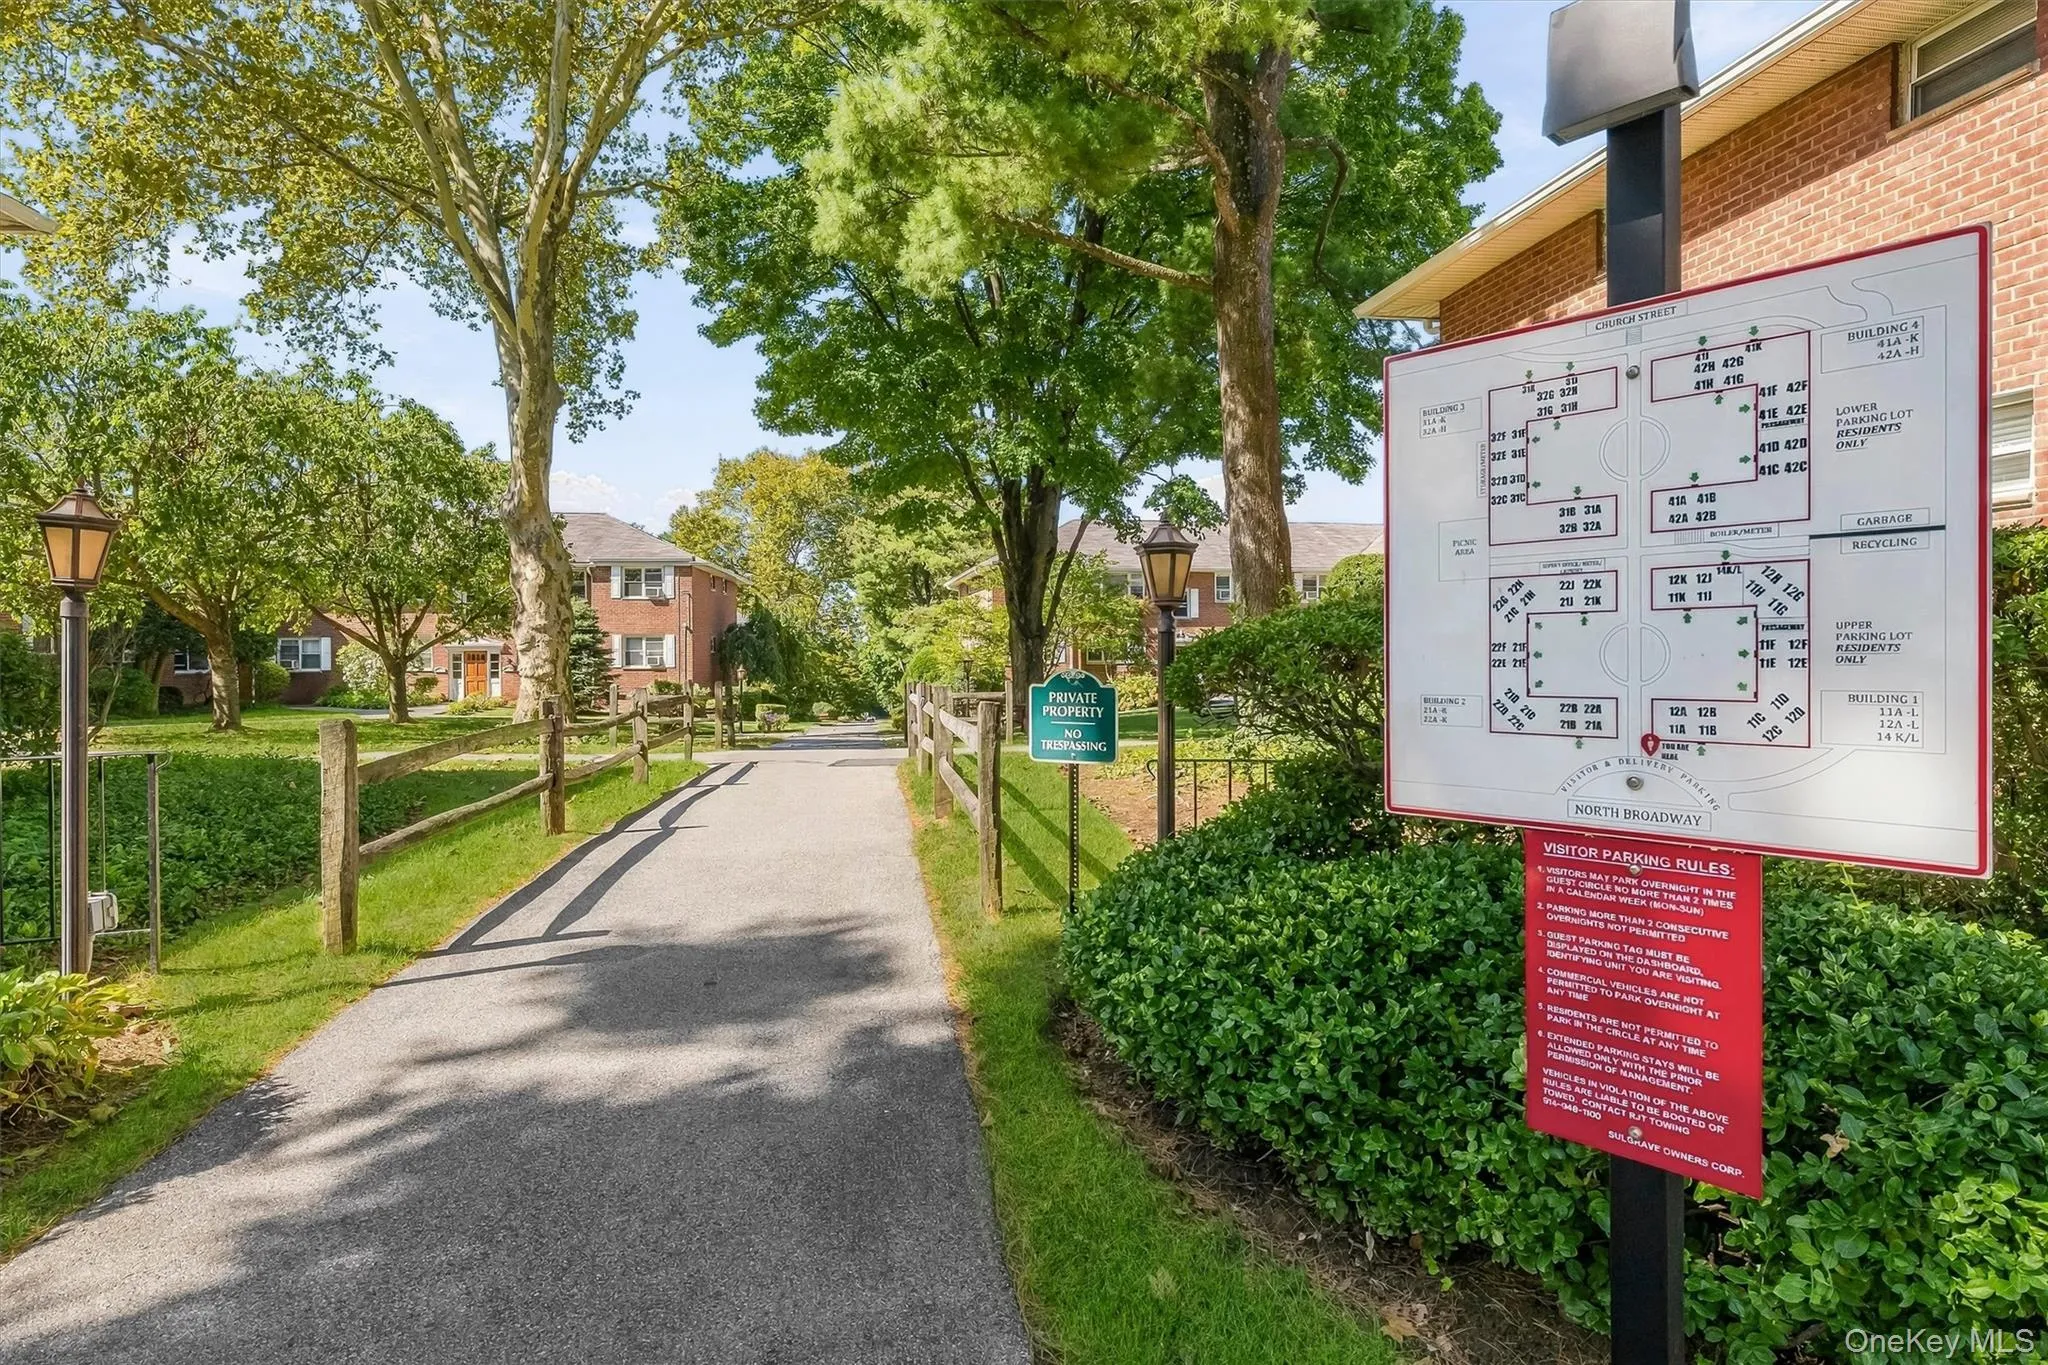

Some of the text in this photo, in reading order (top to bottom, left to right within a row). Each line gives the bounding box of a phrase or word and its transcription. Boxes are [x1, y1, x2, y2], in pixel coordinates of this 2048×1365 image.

[1595, 306, 1677, 330] CHURCH STREET
[1847, 320, 1919, 341] BUILDING 4
[1877, 337, 1902, 348] 41A
[1877, 350, 1902, 360] 42A
[1758, 380, 1808, 398] 41F 42F
[1423, 404, 1458, 417] BUILDING
[1758, 403, 1808, 420] 41E 42E
[1836, 402, 1878, 416] LOWER
[1836, 409, 1914, 427] PARKING LOT
[1491, 429, 1526, 443] 32F 31F
[1836, 422, 1902, 439] RESIDENTS
[1836, 438, 1868, 450] ONLY
[1491, 448, 1526, 462] 32E 31E
[1758, 460, 1808, 476] 41C 42C
[1491, 493, 1526, 505] 32C 31C
[1668, 492, 1716, 506] 41A 41B
[1668, 510, 1717, 524] 42A 42B
[1857, 514, 1913, 526] GARBAGE
[1710, 527, 1773, 538] BOILER/METER
[1852, 537, 1918, 550] RECYCLING
[1455, 548, 1475, 556] AREA
[1836, 621, 1873, 630] UPPER
[1836, 632, 1913, 641] PARKING LOT
[1759, 639, 1808, 650] 11F 12F
[1836, 643, 1901, 652] RESIDENTS
[1759, 658, 1808, 668] 11E 12E
[1835, 655, 1867, 664] ONLY
[1049, 692, 1097, 704] PRIVATE
[1423, 697, 1460, 705] BUILDING
[1848, 694, 1918, 704] BUILDING 1
[1042, 705, 1104, 718] PROPERTY
[1669, 706, 1717, 718] 12A 12B
[1770, 693, 1806, 724] 11D 12D
[1880, 707, 1919, 717] 11A -L
[1669, 724, 1717, 736] 11A 11B
[1747, 712, 1783, 743] 11C 12C
[1880, 720, 1919, 729] 12A -L
[1064, 729, 1082, 739] NO
[1878, 732, 1919, 744] 14 K/L
[1041, 740, 1107, 752] TRESPASSING
[1560, 764, 1599, 793] VISITOR
[1618, 758, 1674, 774] DELIVERY
[1680, 773, 1721, 811] PARKING
[1575, 804, 1702, 826] NORTH BROADWAY
[1543, 842, 1735, 876] VISITOR PARKING RULES:
[1546, 866, 1587, 879] VISITORS
[1589, 872, 1609, 882] MAY
[1612, 876, 1638, 886] PARK
[1641, 879, 1700, 894] OVERNIGHT
[1703, 888, 1713, 896] IN
[1716, 889, 1736, 899] THE
[1546, 876, 1576, 887] GUEST
[1579, 881, 1612, 892] CIRCLE
[1615, 885, 1629, 893] NO
[1631, 887, 1660, 899] MORE
[1663, 892, 1690, 903] THAN
[1702, 898, 1734, 910] TIMES
[1546, 885, 1704, 916] IN A CALENDAR WEEK (MON-SUN)
[1546, 903, 1587, 916] PARKING
[1589, 910, 1616, 920] MORE
[1619, 915, 1645, 926] THAN
[1648, 919, 1653, 927] 2
[1656, 921, 1729, 940] CONSECUTIVE
[1546, 913, 1686, 943] OVERNIGHTS NOT PERMITTED
[1547, 931, 1577, 942] GUEST
[1579, 937, 1621, 950] PARKING
[1623, 944, 1643, 954] TAG
[1646, 949, 1673, 960] MUST
[1676, 953, 1690, 964] BE
[1547, 940, 1704, 977] DISPLAYED ON THE DASHBOARD.
[1547, 1032, 1595, 1050] EXTENDED
[1597, 1044, 1639, 1060] PARKING
[1642, 1055, 1675, 1070] STAYS
[1677, 1064, 1703, 1077] WILL
[1705, 1071, 1720, 1081] BE
[1547, 1042, 1703, 1087] ALLOWED ONLY WITH THE PRIOR
[1547, 1050, 1694, 1095] PERMISSION OF MANAGEMENT.
[1543, 1067, 1729, 1124] VEHICLES IN VIOLATION OF THE ABOVE
[1543, 1077, 1724, 1134] RULES ARE LIABLE TO BE BOOTED OR
[1581, 1098, 1626, 1117] CONTACT
[1629, 1112, 1647, 1122] RJT
[1649, 1117, 1690, 1135] TOWING
[1608, 1130, 1745, 1178] SULGRAVE OWNERS CORP.
